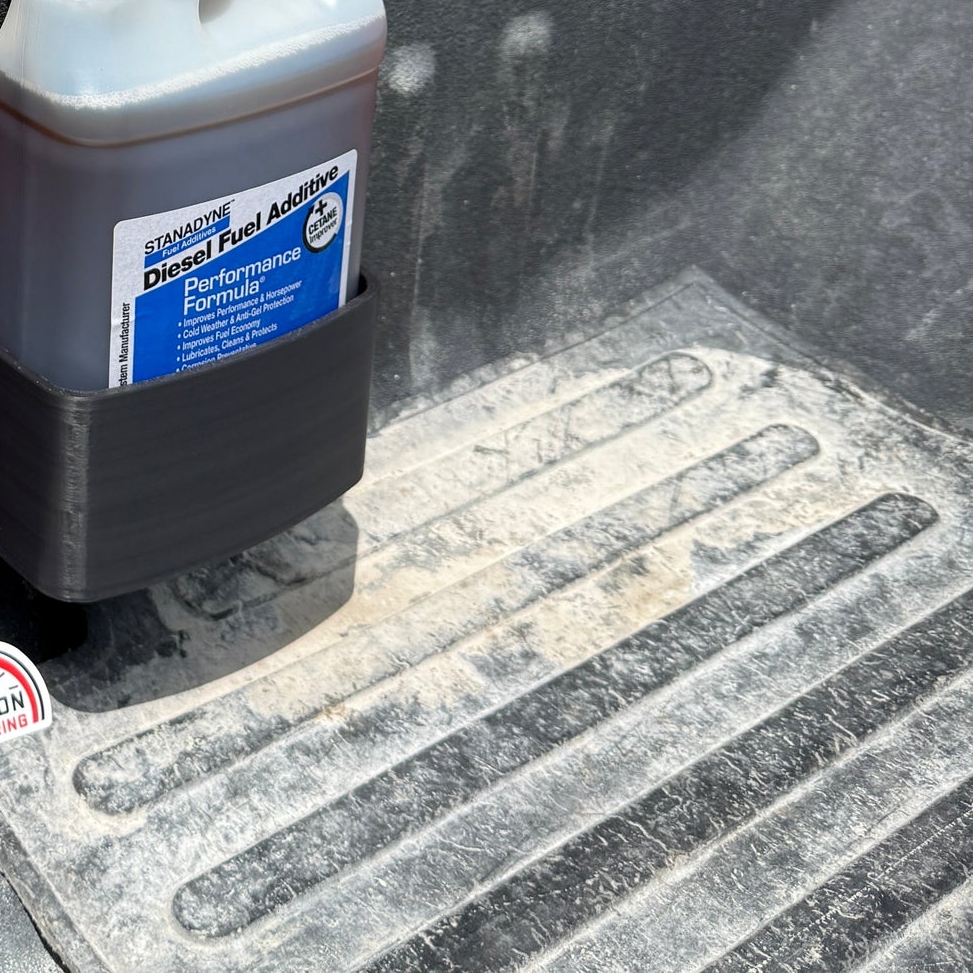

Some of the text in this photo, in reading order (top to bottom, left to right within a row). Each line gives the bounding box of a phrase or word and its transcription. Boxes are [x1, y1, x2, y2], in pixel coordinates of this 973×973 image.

[143, 165, 339, 291] Diesel Fuel Additive
[162, 226, 217, 258] Fuel Additives
[308, 206, 338, 235] CETANE
[184, 246, 301, 297] Performance
[182, 294, 295, 339] Cold Weather & Anti-Gel Protection
[183, 280, 303, 328] Improves Performance & Horsepower
[118, 302, 131, 363] Manufacturer
[182, 318, 262, 351] Improves Fuel Economy
[221, 336, 245, 349] Cleans
[245, 331, 251, 342] &
[251, 322, 278, 339] Protects
